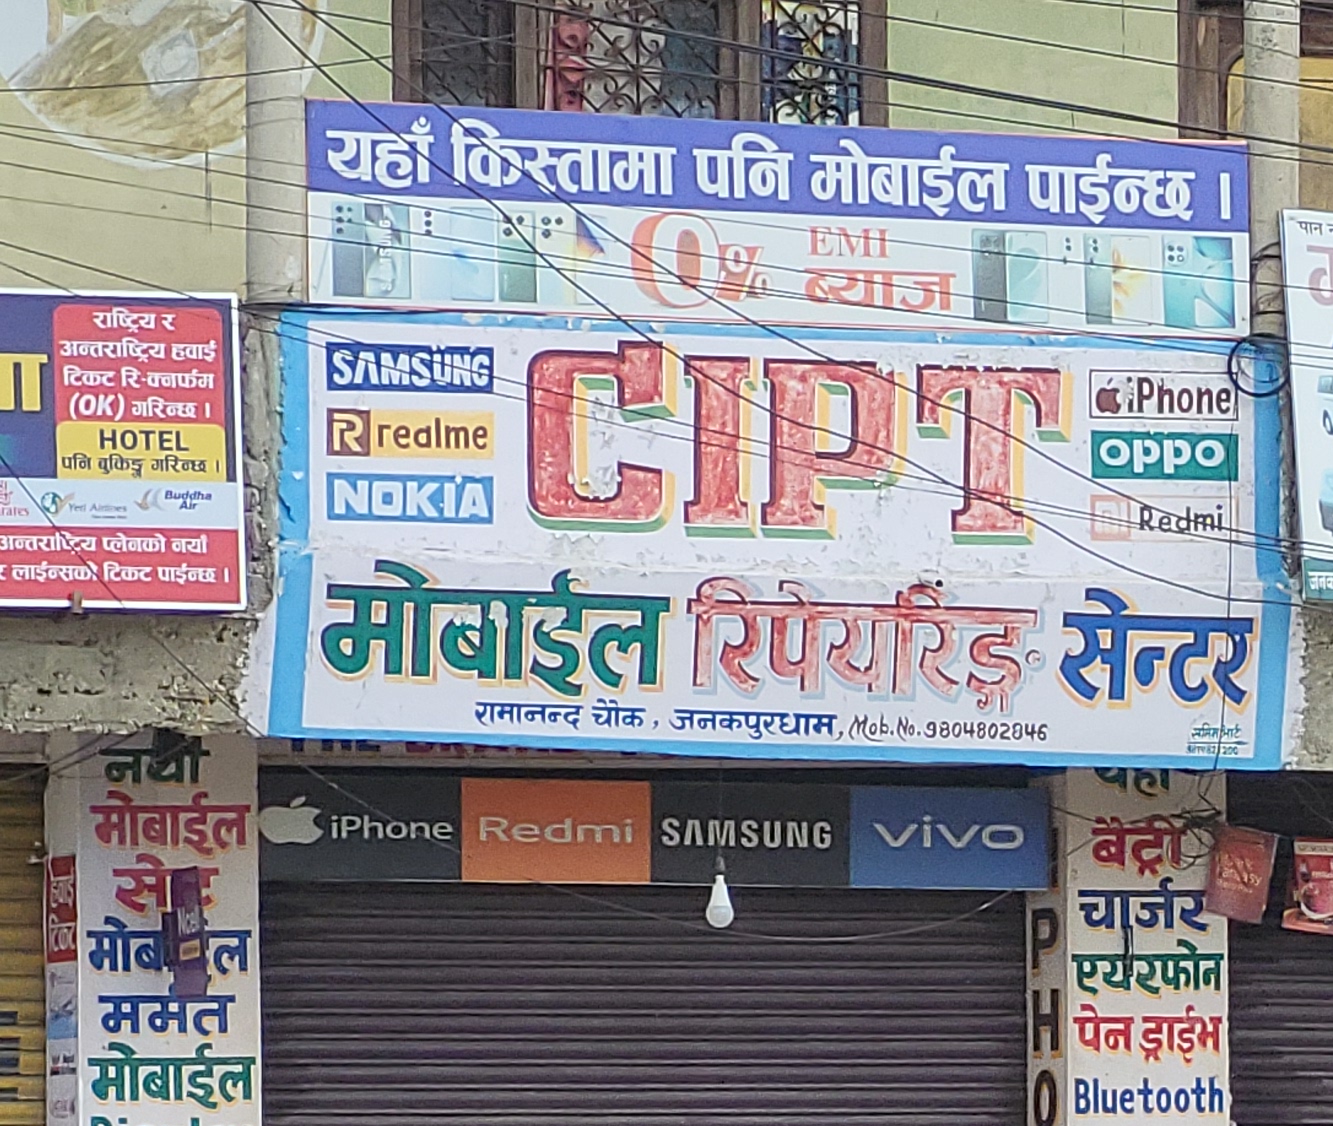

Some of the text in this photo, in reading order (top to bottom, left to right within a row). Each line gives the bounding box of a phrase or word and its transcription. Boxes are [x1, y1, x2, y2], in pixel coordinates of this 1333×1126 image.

[326, 115, 1196, 224] यहाँ किस्तामा पनि मोबाईल पाईन्छ
[808, 226, 890, 259] EMI
[1297, 220, 1323, 236] पान
[630, 211, 956, 312] 0% ब्याज
[92, 306, 177, 334] राष्ट्रिय र
[59, 339, 219, 364] अन्तराष्ट्रिय हवाई
[331, 345, 491, 388] SAMSUNG
[62, 367, 116, 388] टिकट
[69, 392, 199, 422] (OK) गरिन्छ
[1126, 375, 1233, 417] iPhone
[99, 428, 190, 451] HOTEL
[376, 416, 489, 453] realme
[525, 338, 1074, 547] CIPT
[61, 453, 208, 475] पनि गरिन्छ
[164, 489, 213, 502] Buddha
[179, 499, 199, 512] Air
[333, 477, 491, 521] NOKIA
[1138, 503, 1224, 534] Redmi
[101, 531, 167, 554] प्लेनको
[103, 562, 154, 583] टिकट
[157, 564, 217, 585] पाईन्छ
[320, 559, 1258, 714] मोबाईल सेन्टर
[475, 700, 583, 730] रामानन्द
[88, 789, 252, 858] मोबाईल
[330, 812, 1027, 852] iPhone Redmi SAMSUNG vivo
[1072, 1003, 1135, 1054] पेन
[87, 1041, 257, 1110] मोबाईल
[1074, 1076, 1225, 1116] Bluetooth
